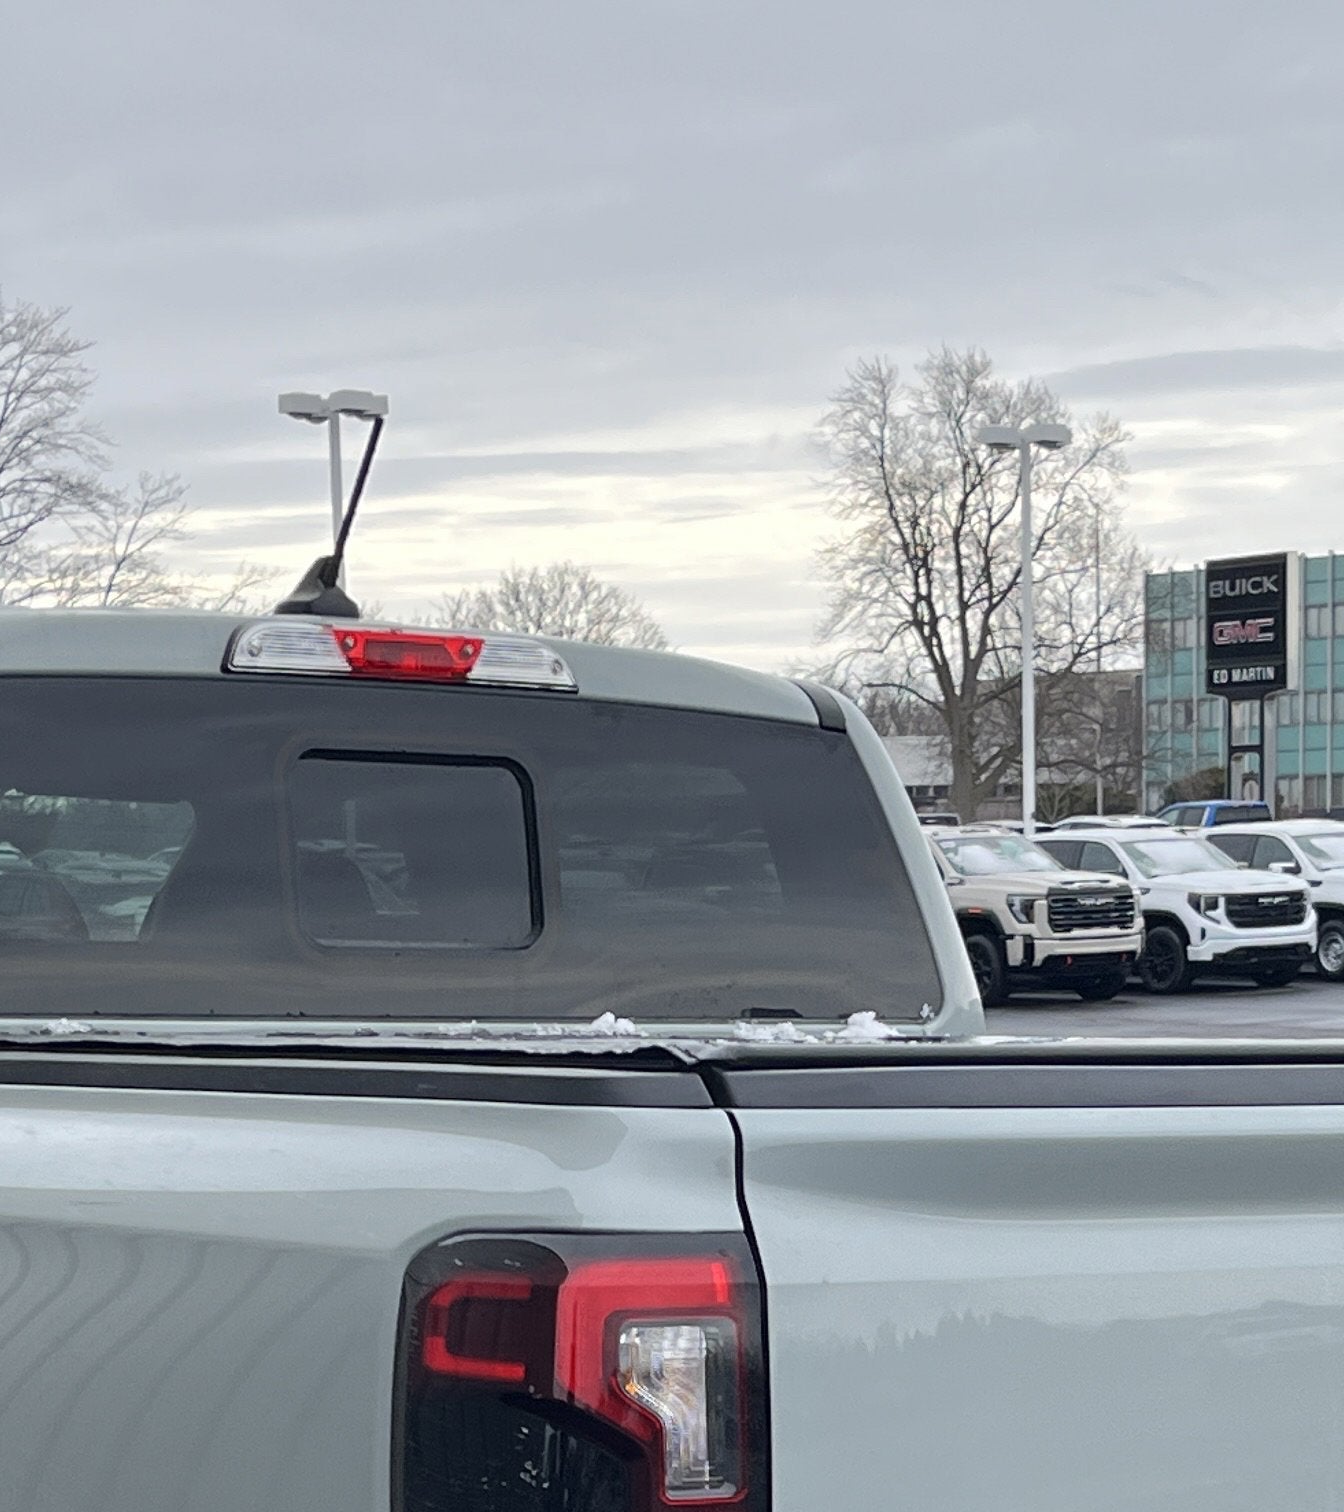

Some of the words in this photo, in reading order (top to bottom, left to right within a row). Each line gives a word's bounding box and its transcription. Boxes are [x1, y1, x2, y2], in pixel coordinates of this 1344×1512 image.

[1209, 575, 1278, 598] BUICK
[1213, 617, 1274, 645] GMC
[1213, 669, 1228, 684] ED
[1231, 666, 1274, 682] MARTIN
